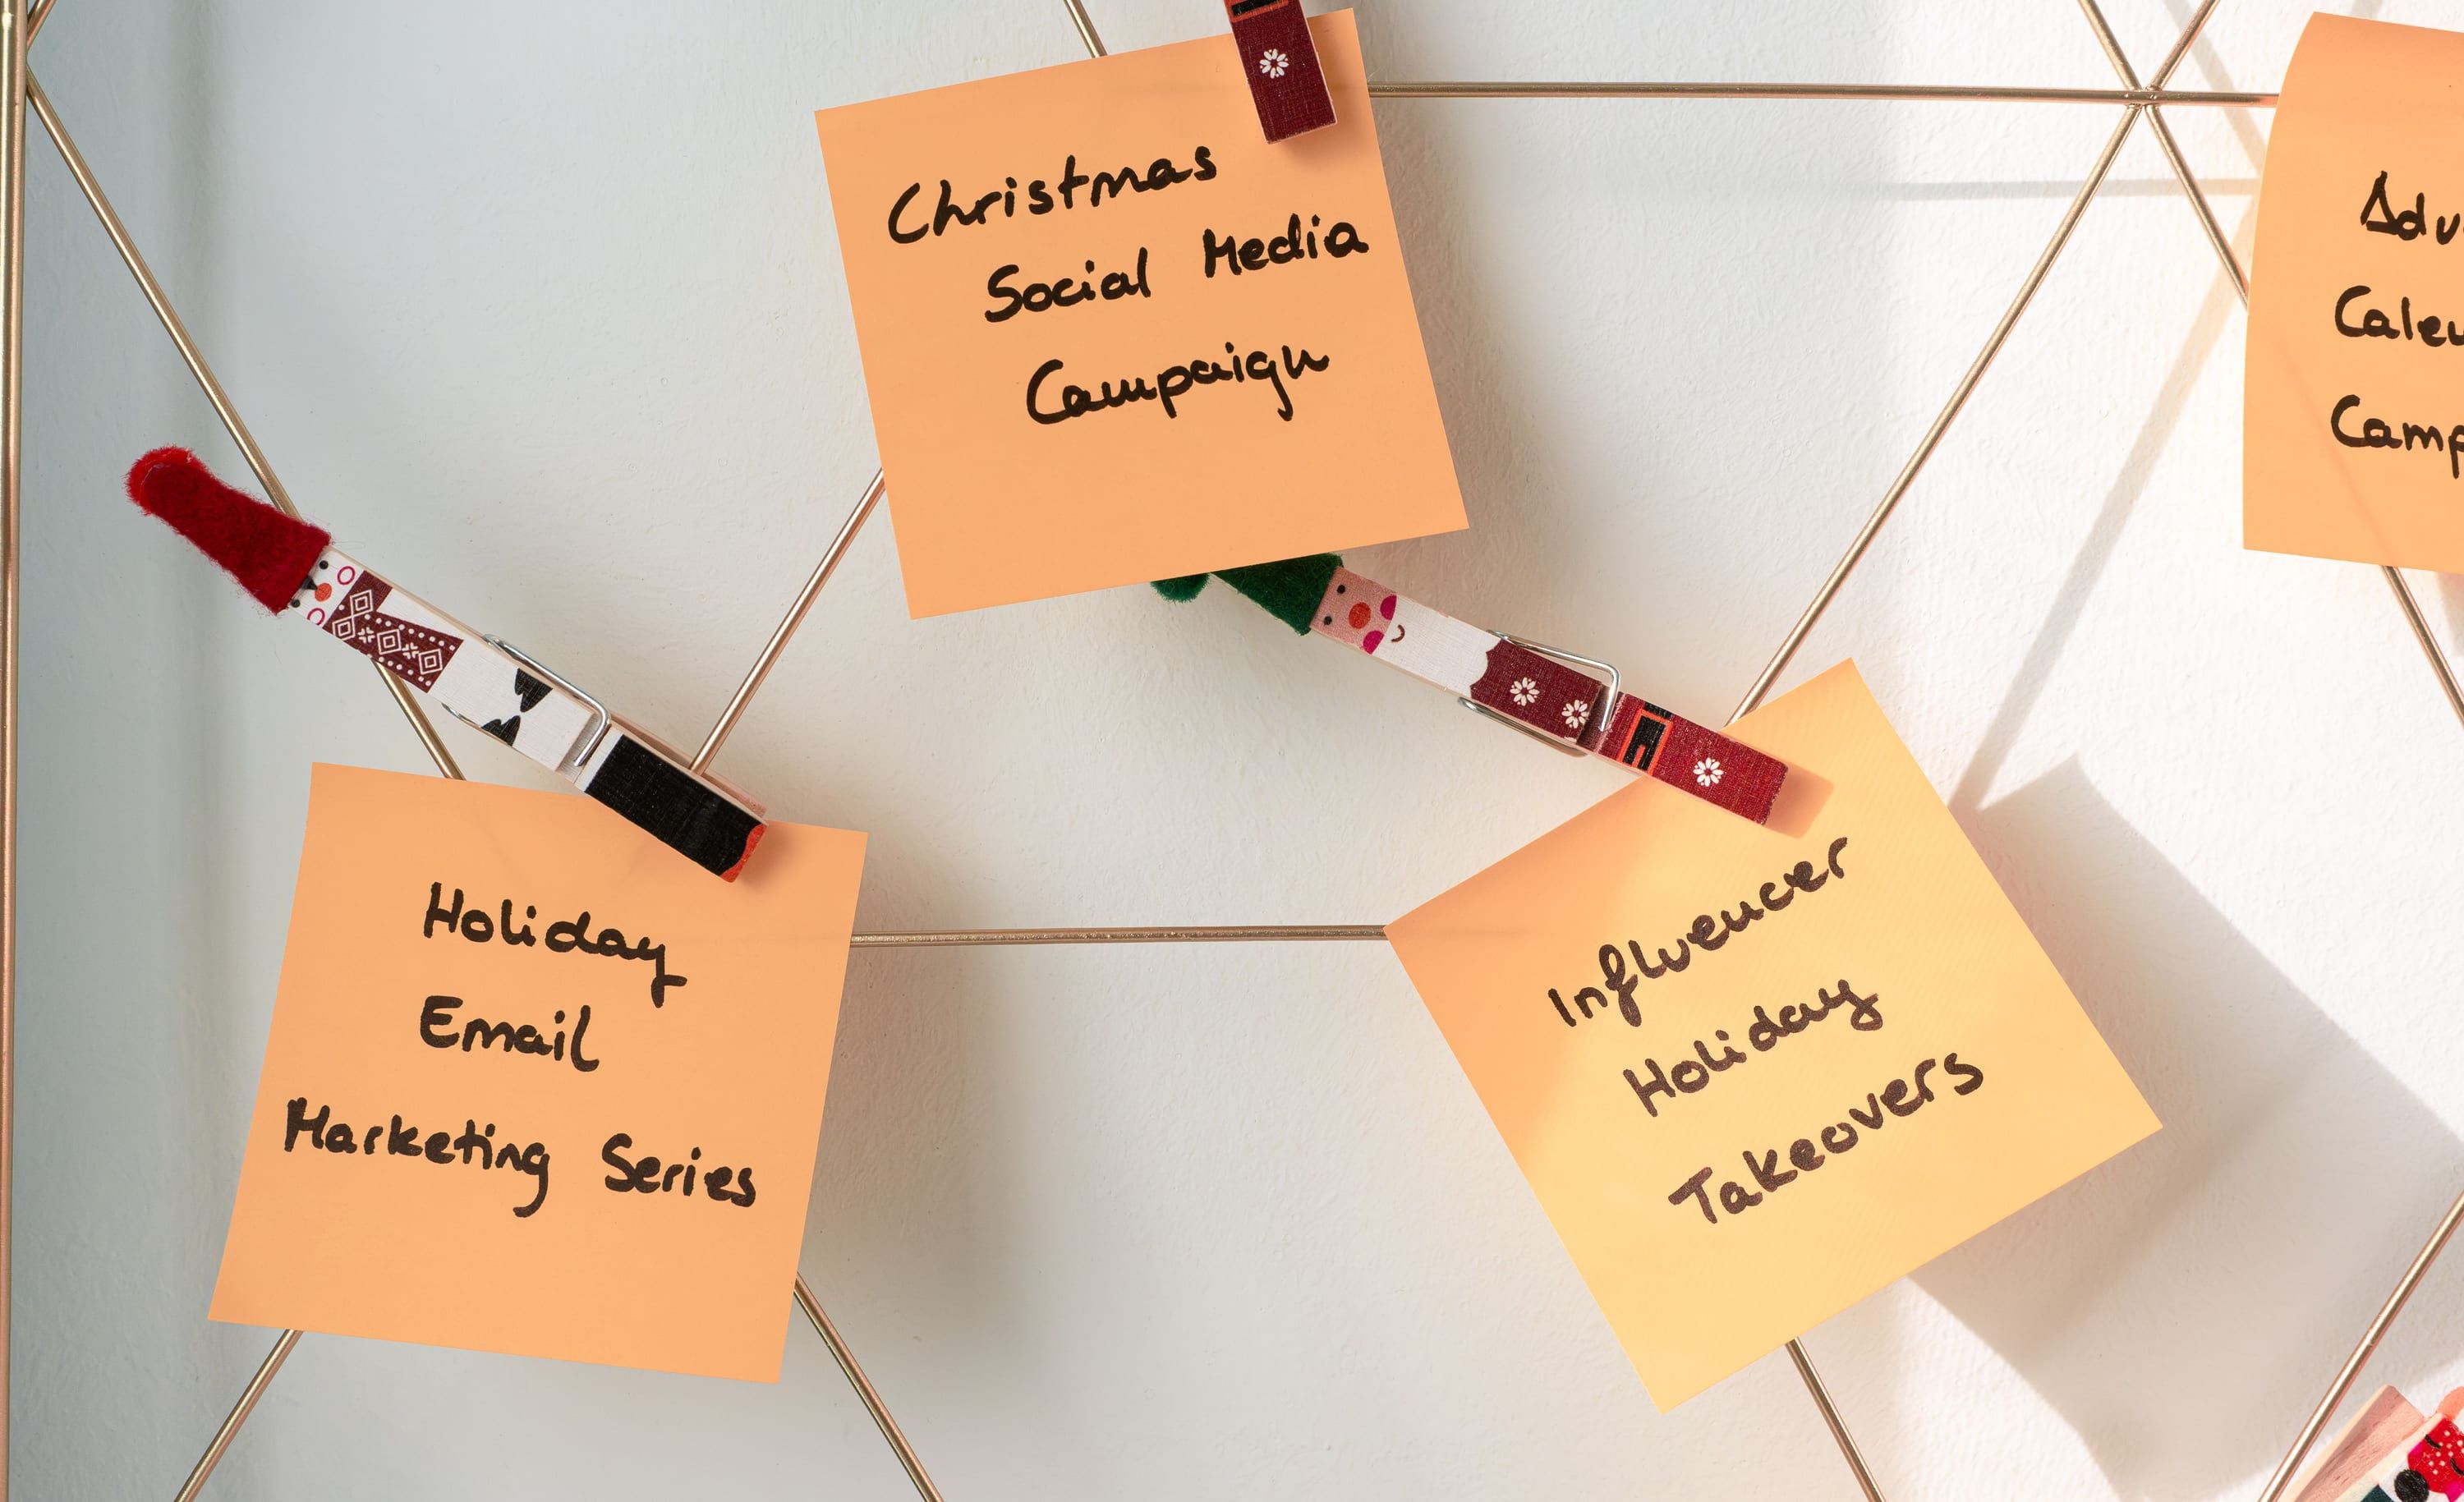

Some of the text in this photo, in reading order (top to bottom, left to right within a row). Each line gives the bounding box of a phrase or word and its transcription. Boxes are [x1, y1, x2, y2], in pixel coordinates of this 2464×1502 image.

[888, 145, 1217, 244] Christmas
[2360, 170, 2464, 246] Adv
[985, 213, 1369, 323] Social Media
[1026, 342, 1330, 425] Campaign
[423, 881, 687, 1008] Holiday
[1547, 836, 1848, 1027] Influencer
[420, 995, 600, 1073] Email
[1623, 980, 1883, 1118] Holiday
[284, 1097, 756, 1218] Marketing Series
[1668, 1051, 1984, 1224] Takeovers
